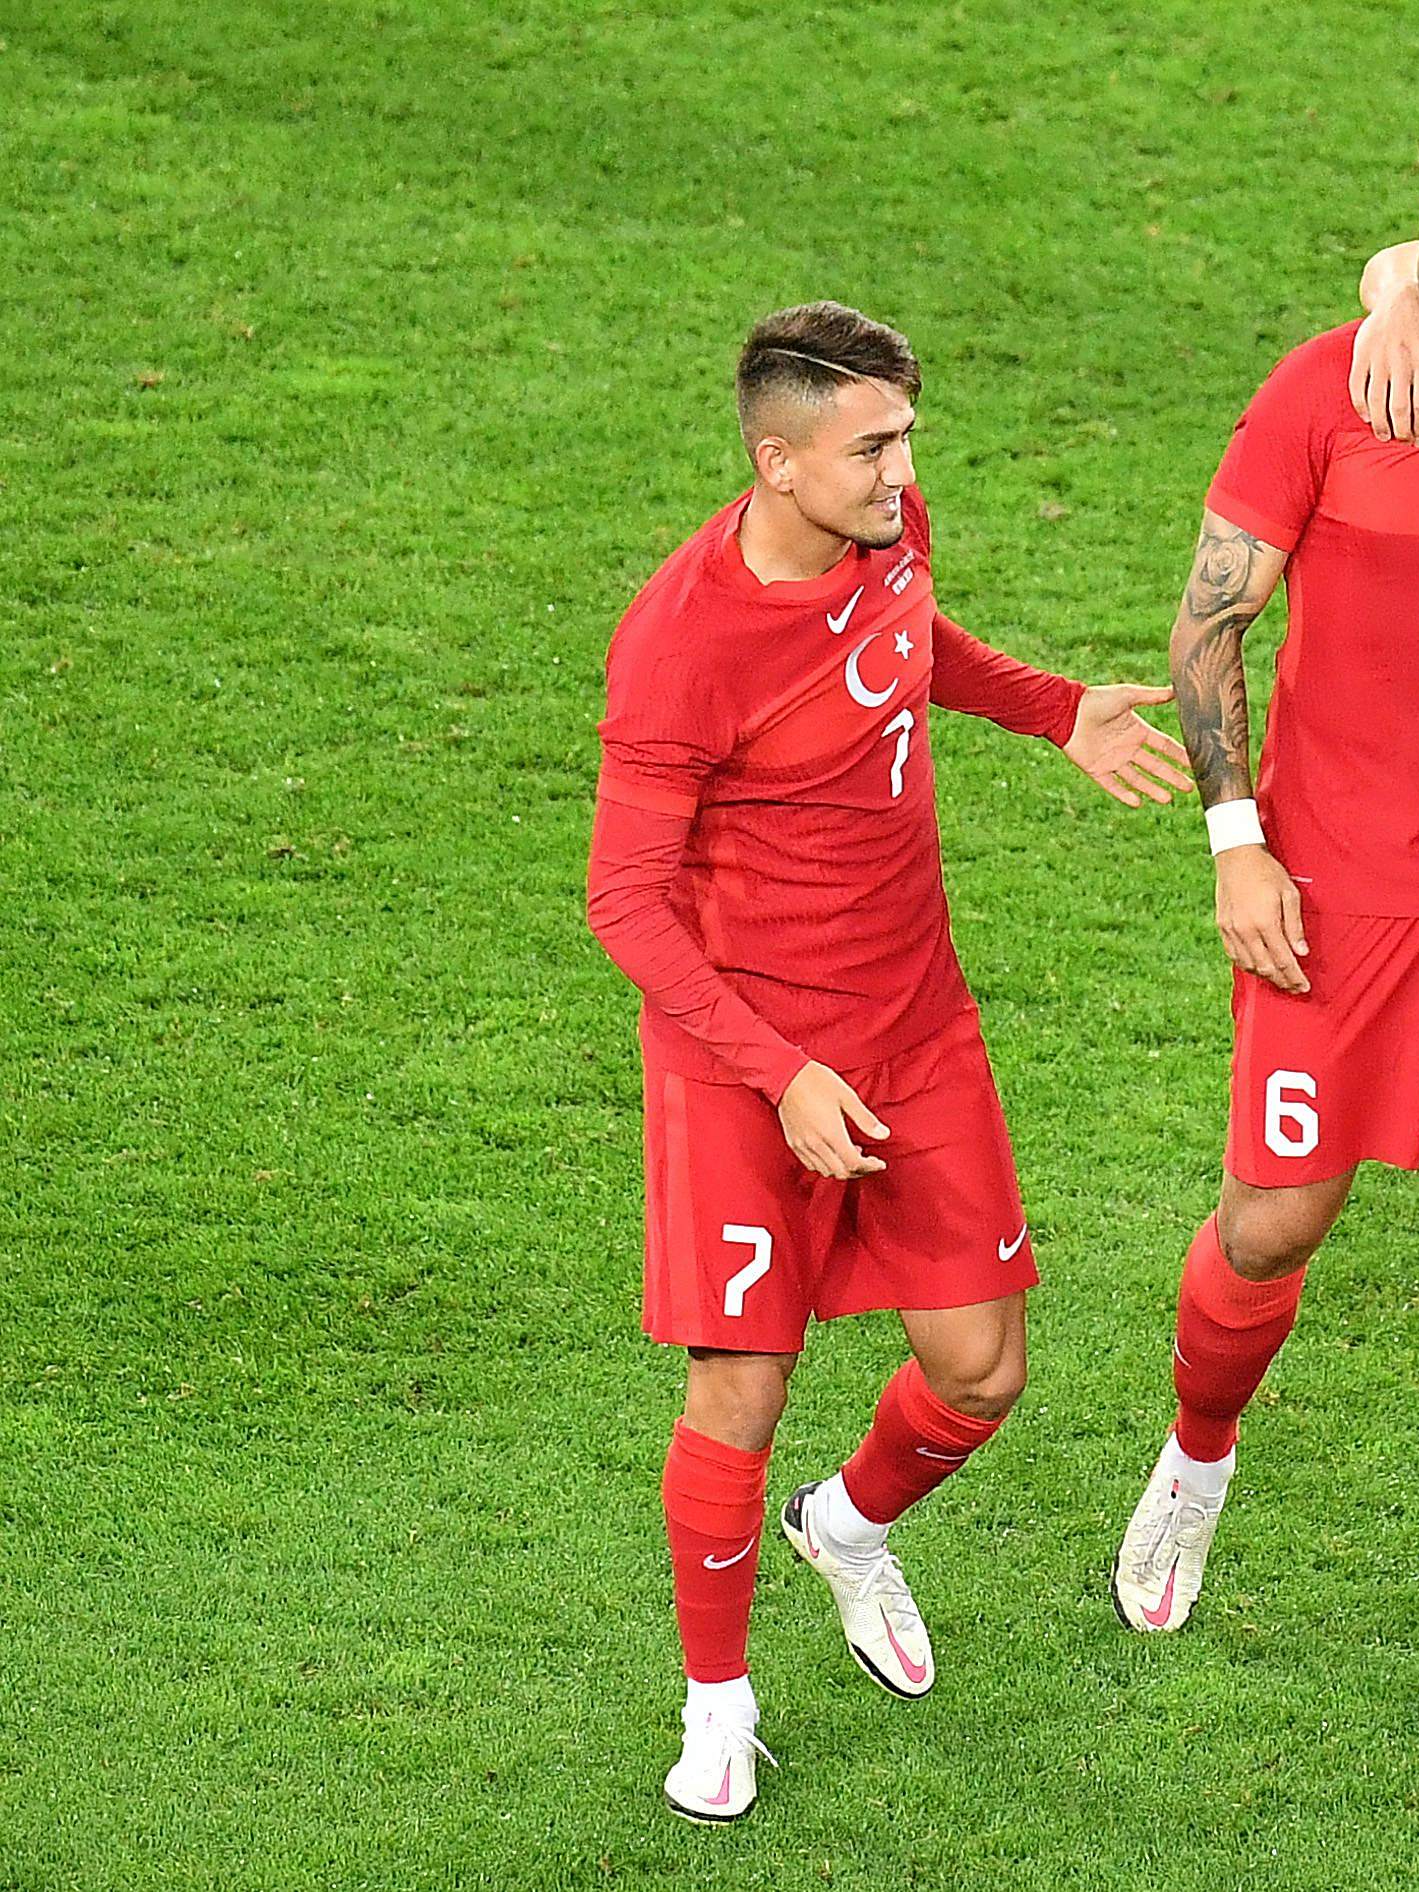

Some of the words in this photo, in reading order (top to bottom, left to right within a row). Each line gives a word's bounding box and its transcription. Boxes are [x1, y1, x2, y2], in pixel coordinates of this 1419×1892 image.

[881, 707, 915, 799] 7
[1265, 1069, 1319, 1157] 6
[722, 1224, 772, 1317] 7
